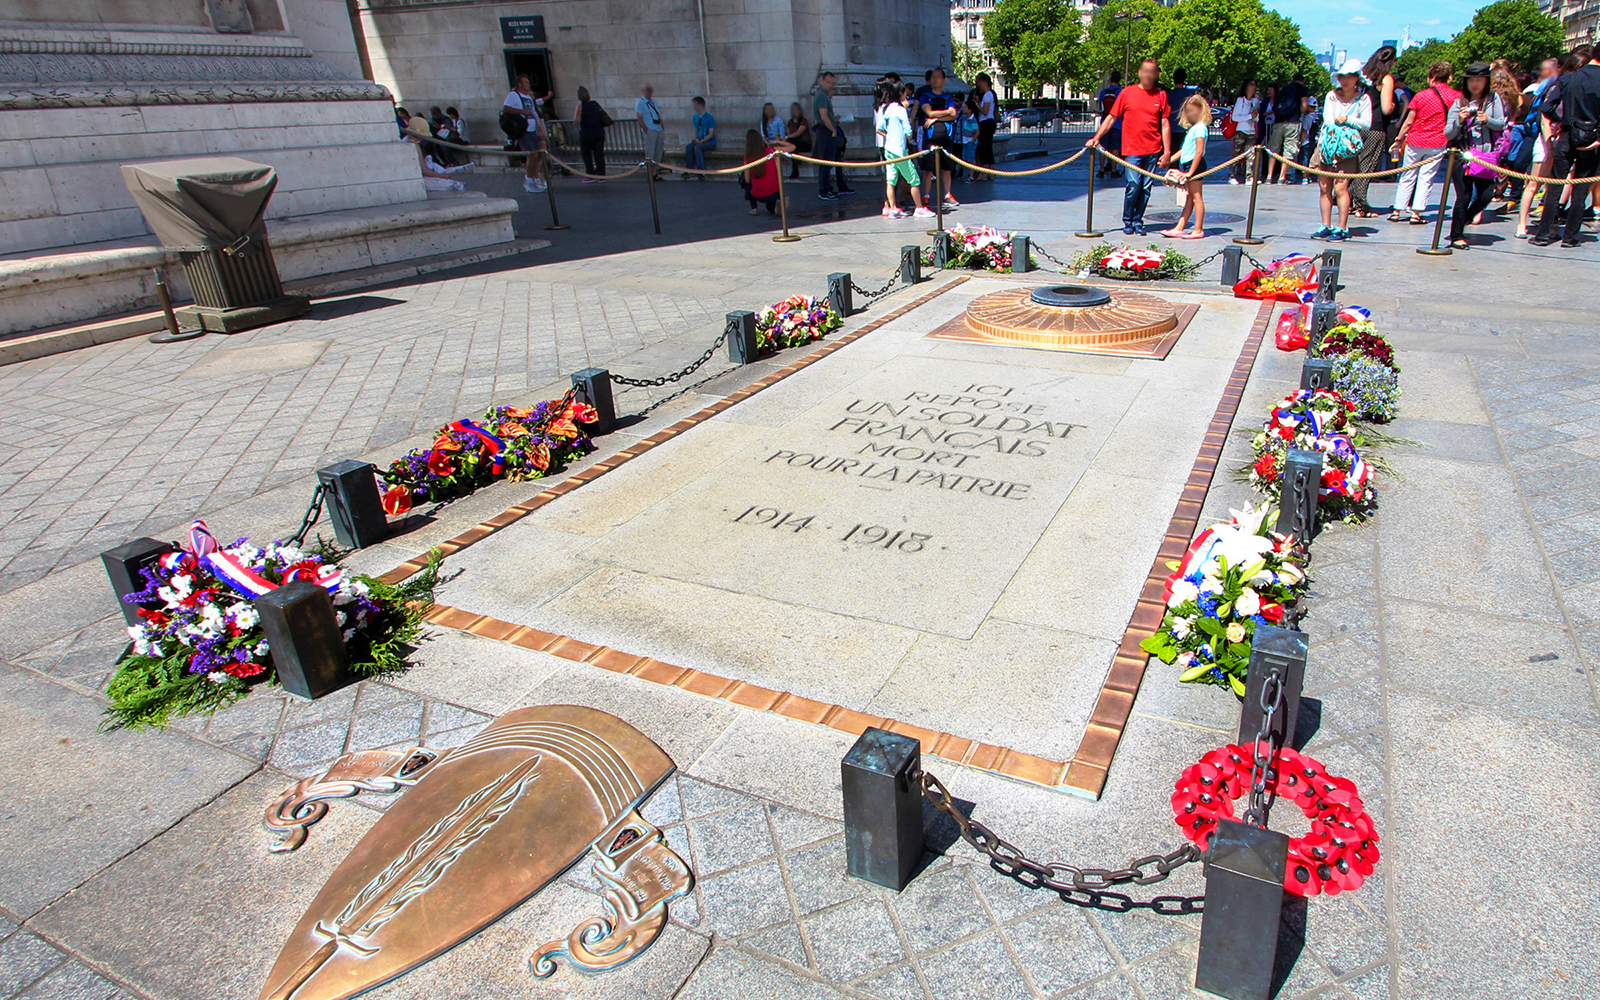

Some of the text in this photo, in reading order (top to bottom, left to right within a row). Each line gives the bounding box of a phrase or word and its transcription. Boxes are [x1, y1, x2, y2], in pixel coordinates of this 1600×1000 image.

[961, 383, 1016, 397] ICI
[904, 391, 1048, 416] REPOSE
[845, 399, 1088, 438] UN SOLDAT
[857, 442, 981, 468] MORT
[761, 449, 1033, 501] POUR LA PATRIE
